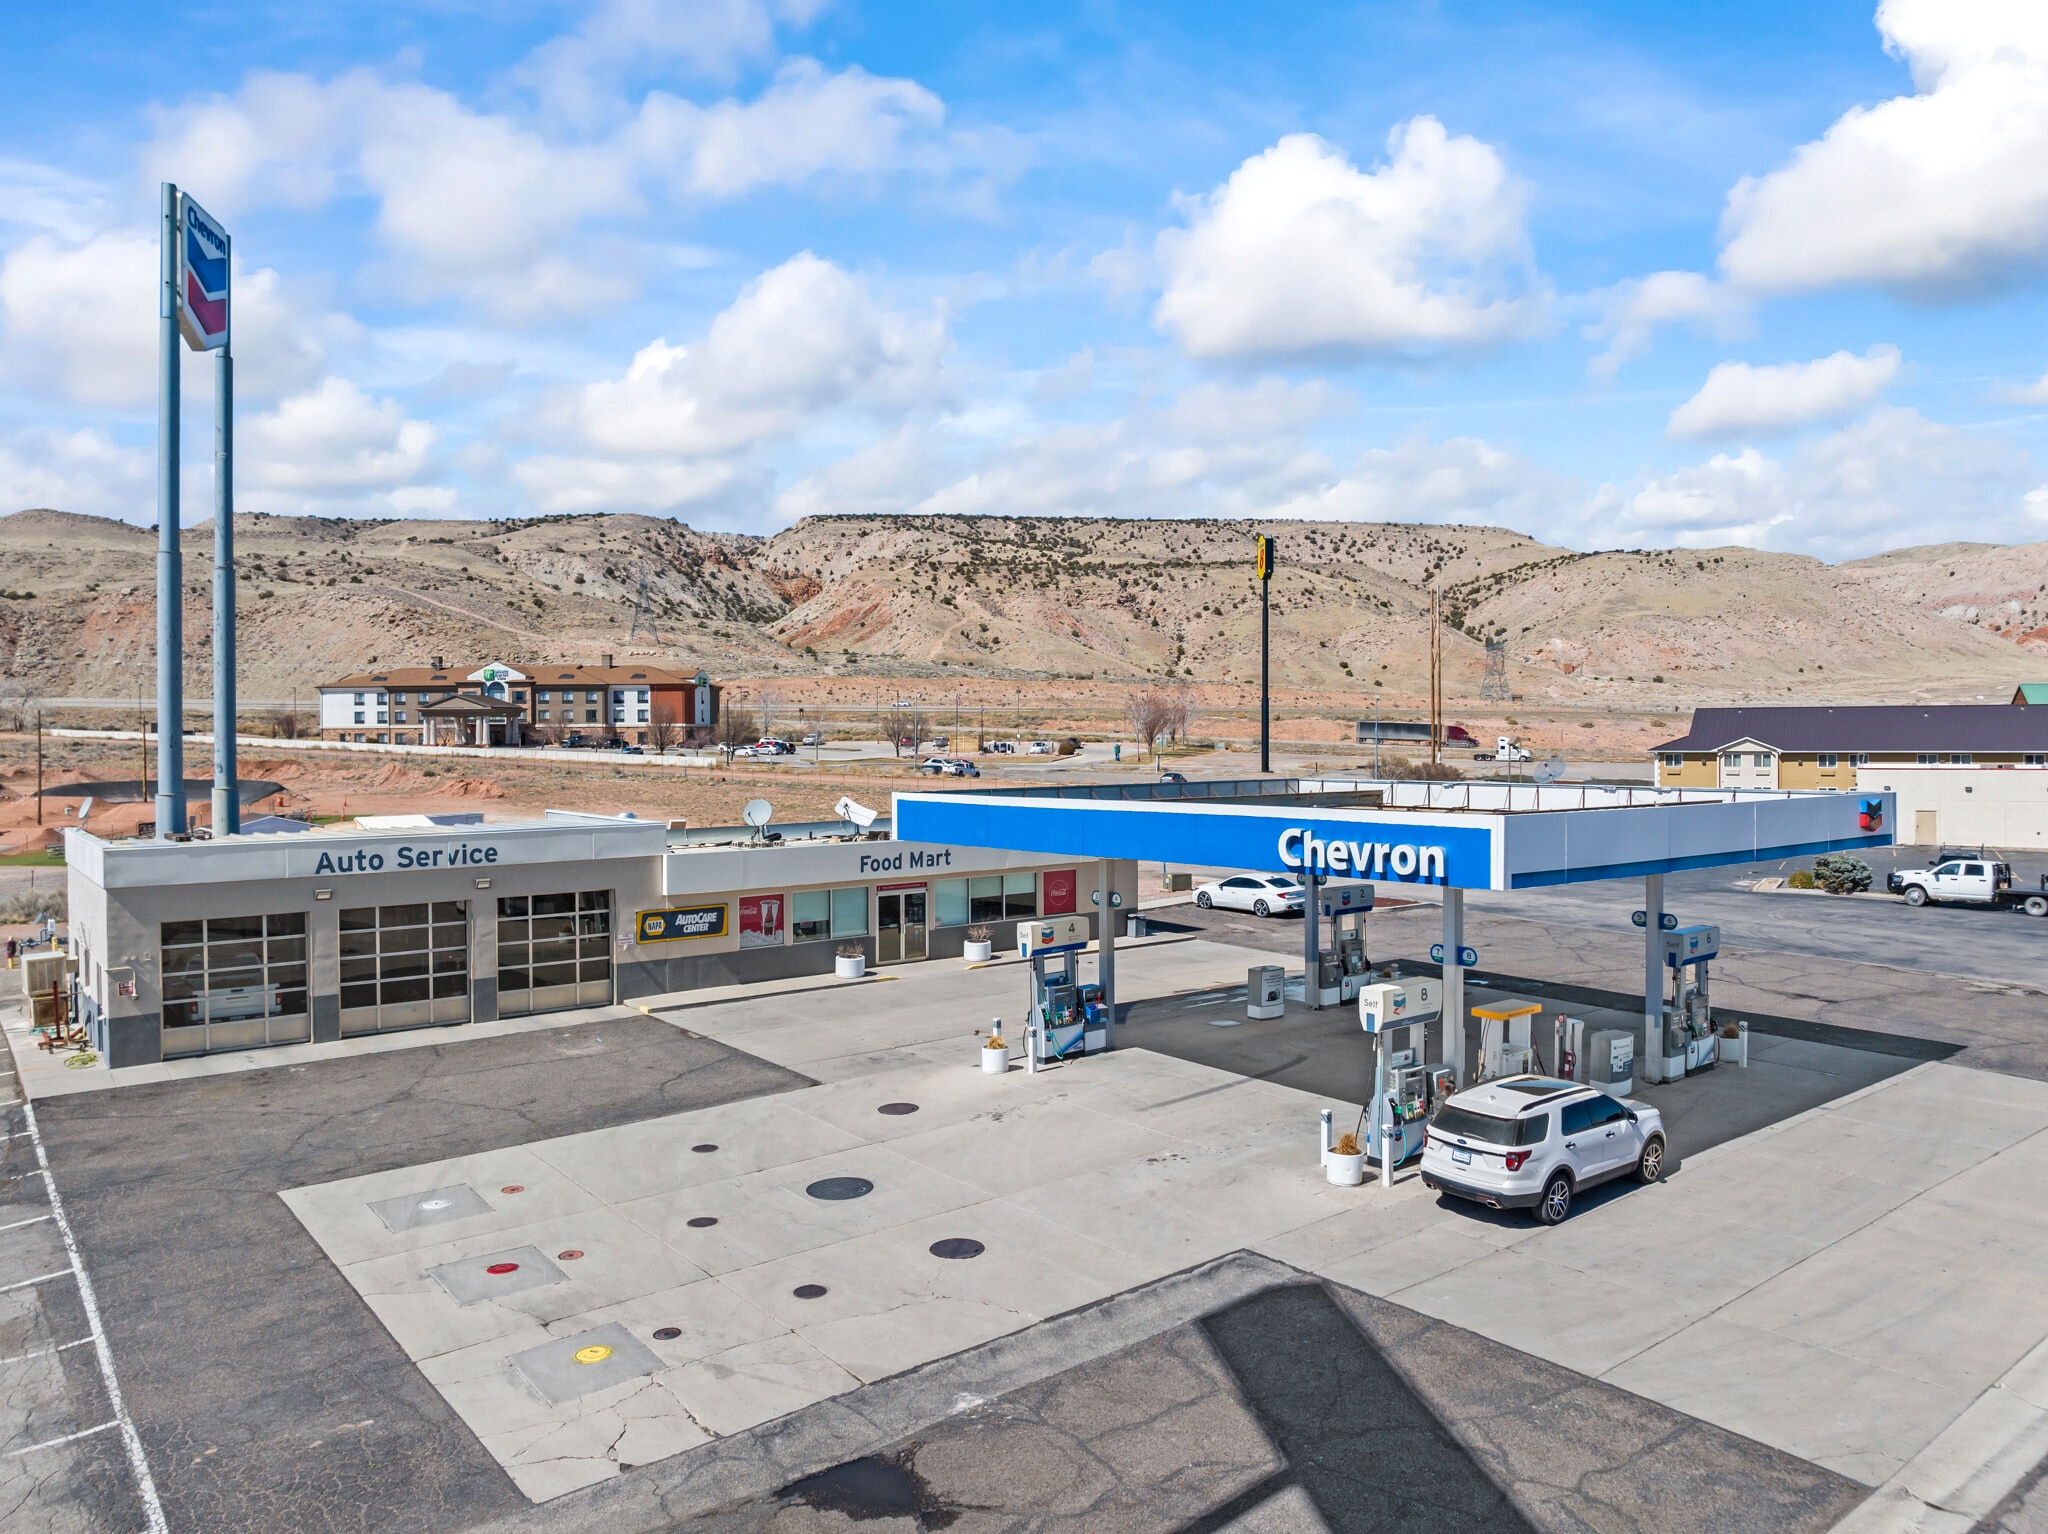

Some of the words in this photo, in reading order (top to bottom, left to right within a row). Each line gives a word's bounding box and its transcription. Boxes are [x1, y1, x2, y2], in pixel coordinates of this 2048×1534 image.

[188, 206, 226, 256] Chevron
[315, 850, 384, 874] Auto
[397, 843, 498, 868] Service
[1278, 828, 1445, 878] Chevron
[860, 853, 902, 873] Food
[910, 848, 952, 869] Mart
[1360, 889, 1365, 898] 2
[646, 920, 663, 932] NAPA
[683, 923, 709, 933] CENTER
[1068, 922, 1076, 933] 4
[1706, 933, 1712, 944] 6
[1420, 988, 1428, 1001] 8
[1364, 999, 1378, 1008] Self
